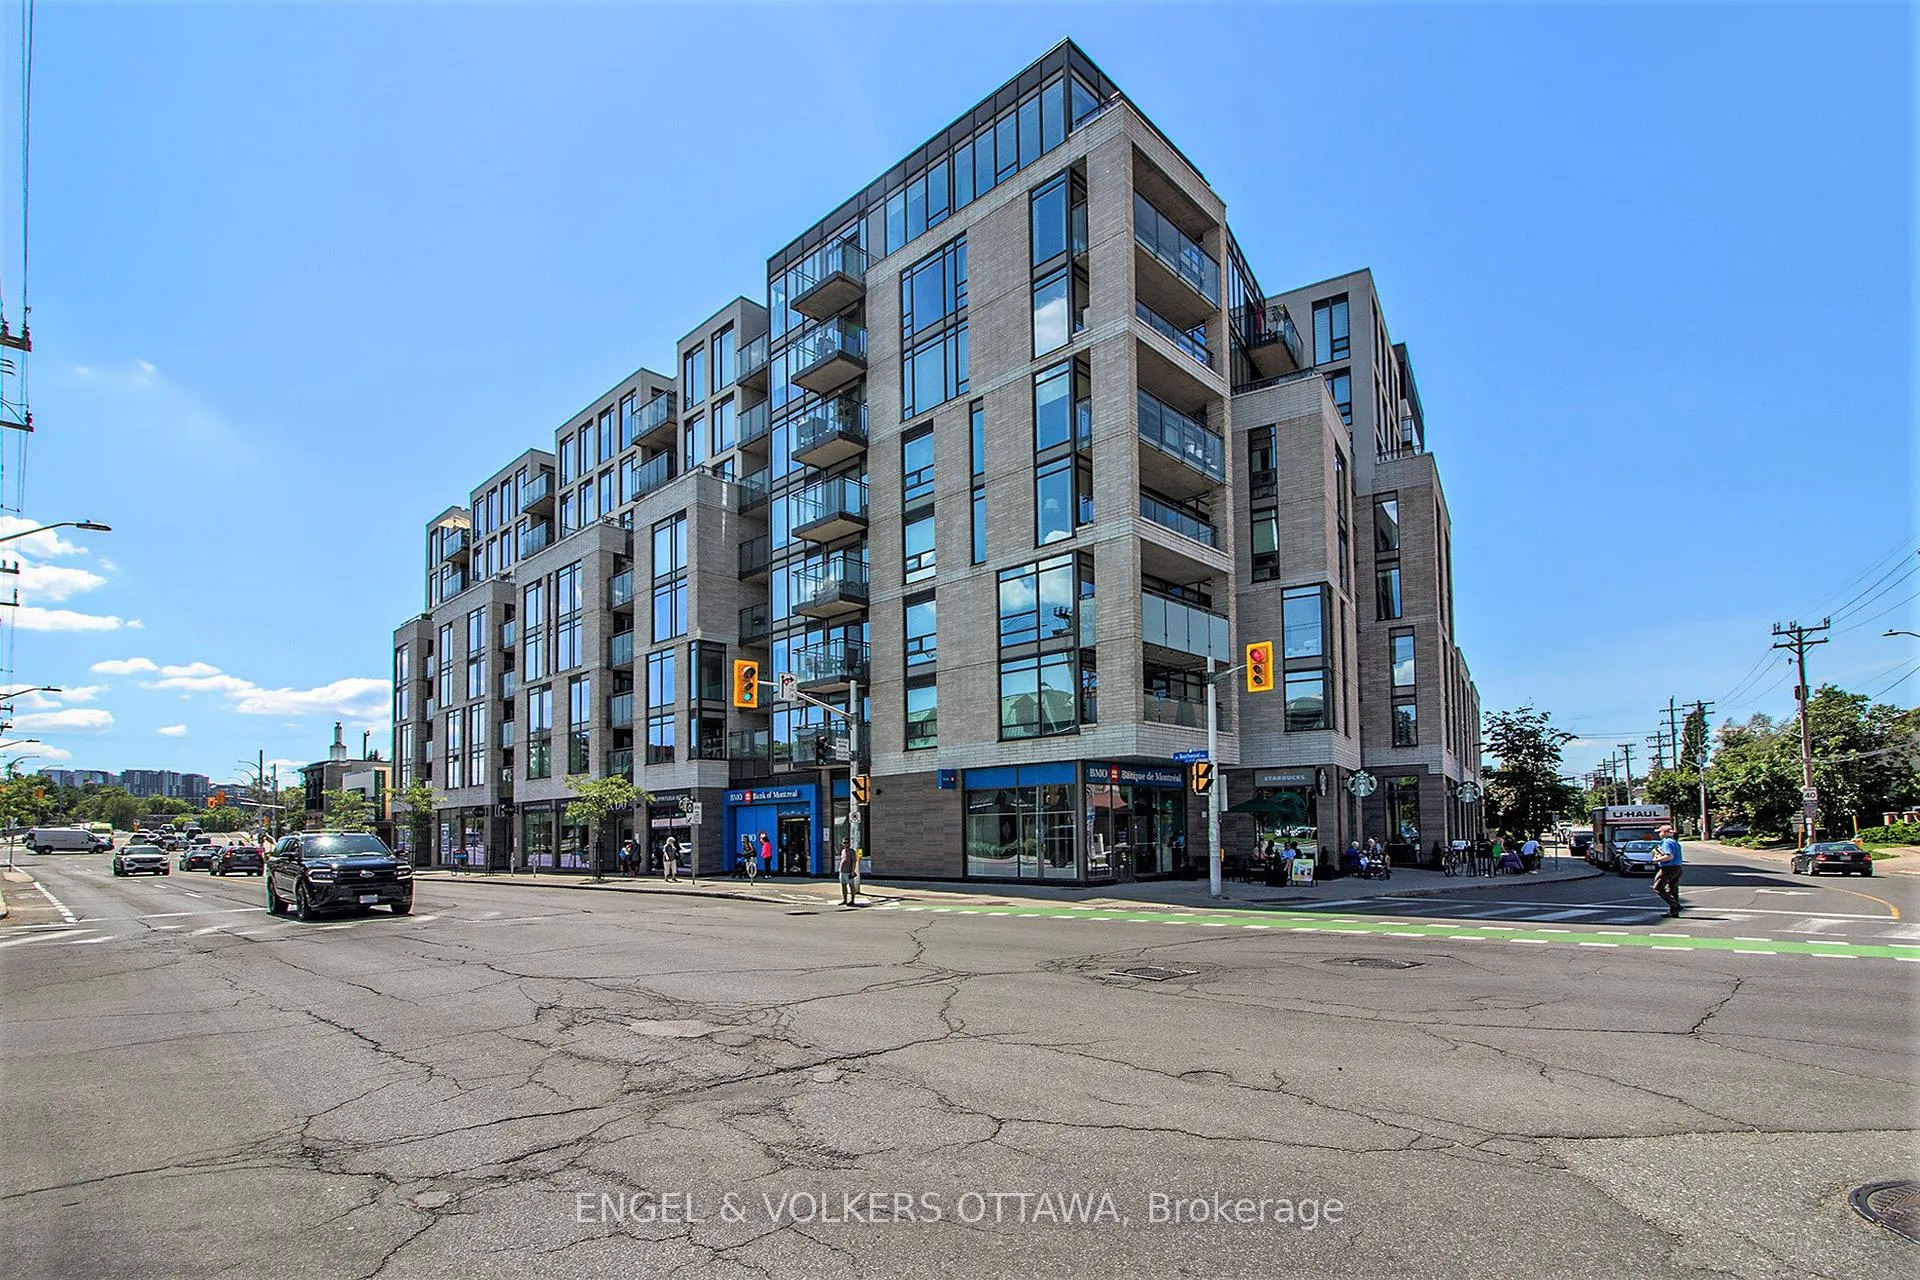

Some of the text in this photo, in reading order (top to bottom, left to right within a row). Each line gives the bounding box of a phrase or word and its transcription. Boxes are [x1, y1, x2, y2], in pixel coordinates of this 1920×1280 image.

[1089, 768, 1182, 783] BMO Banque de Montréal
[752, 792, 766, 800] Bank
[773, 789, 798, 799] Montreal
[1612, 810, 1661, 818] U-HAUL
